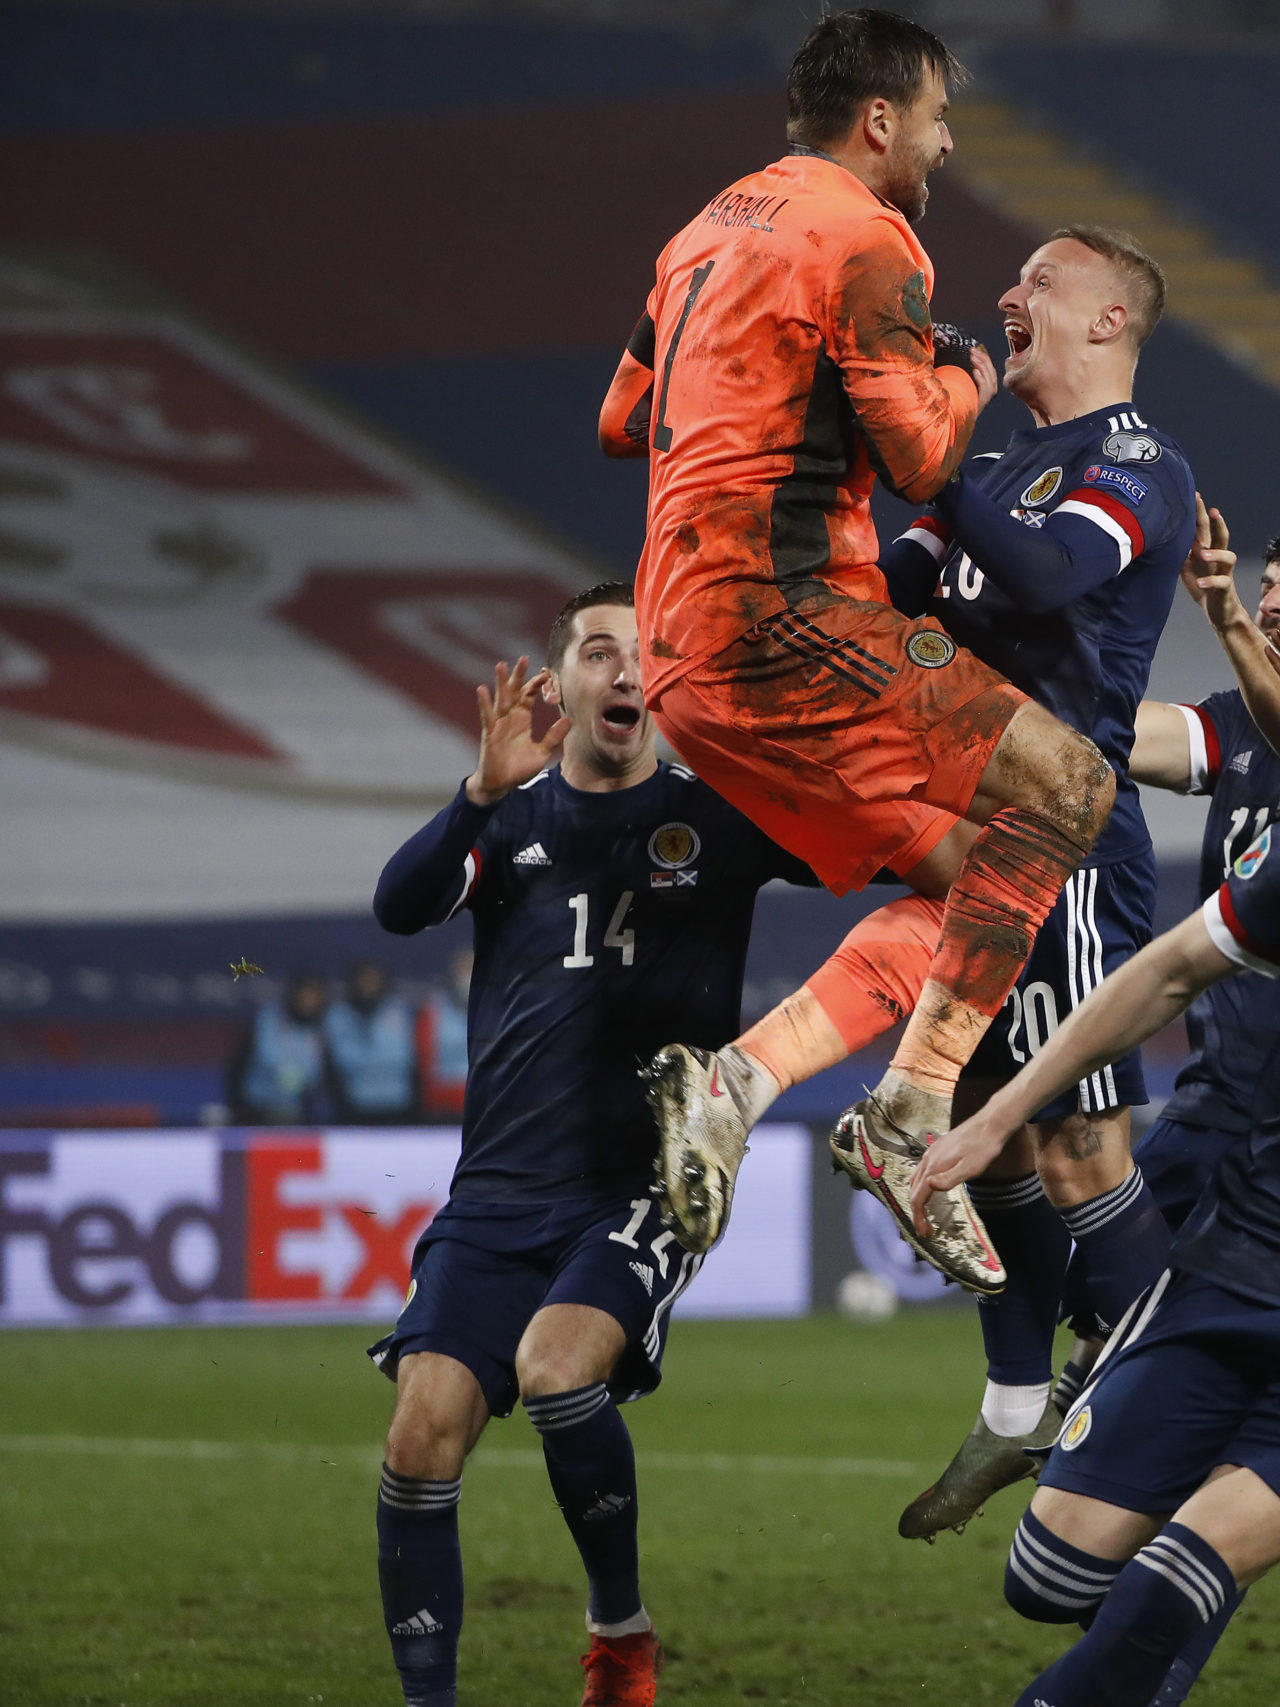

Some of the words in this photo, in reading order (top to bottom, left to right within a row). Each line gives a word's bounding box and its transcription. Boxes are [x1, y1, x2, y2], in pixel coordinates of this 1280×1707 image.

[653, 260, 716, 453] 1
[1099, 469, 1146, 500] RESPECT
[512, 854, 552, 866] adidas
[562, 890, 636, 969] 14
[1002, 981, 1060, 1064] 20
[628, 1261, 653, 1297] adidas
[392, 1622, 444, 1636] adidas
